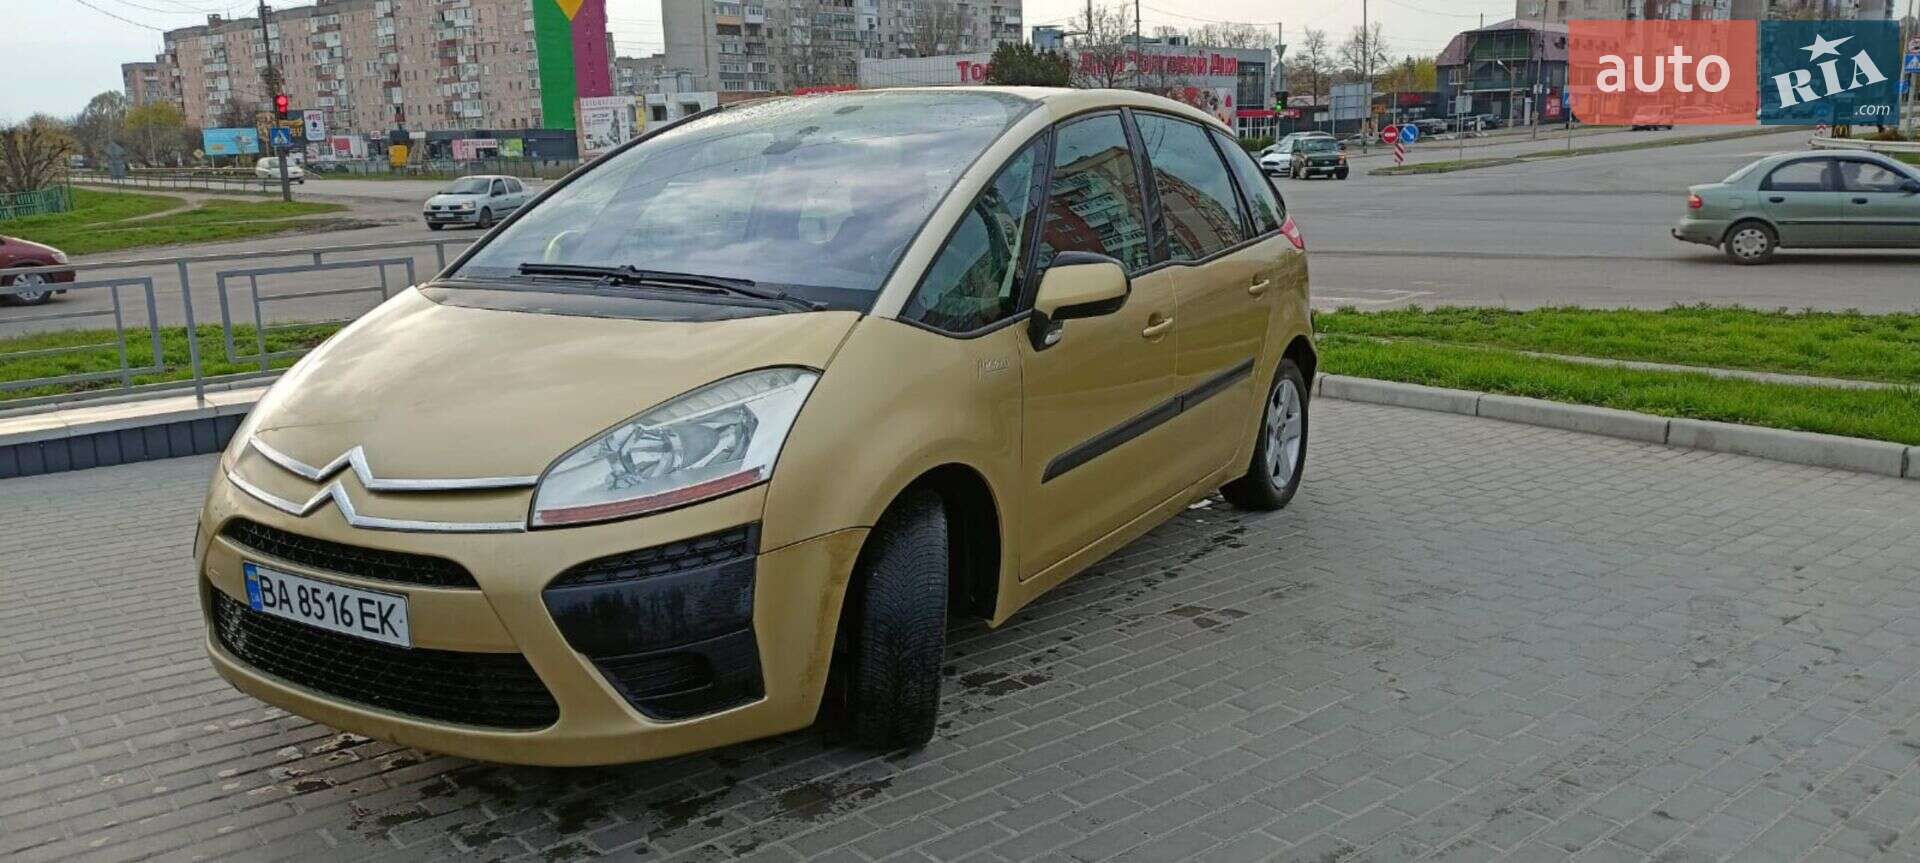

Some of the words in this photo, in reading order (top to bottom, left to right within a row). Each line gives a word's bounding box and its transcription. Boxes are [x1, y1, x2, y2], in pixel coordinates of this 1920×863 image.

[259, 575, 294, 613] BA
[297, 584, 354, 628] 8516
[358, 597, 399, 638] EK
